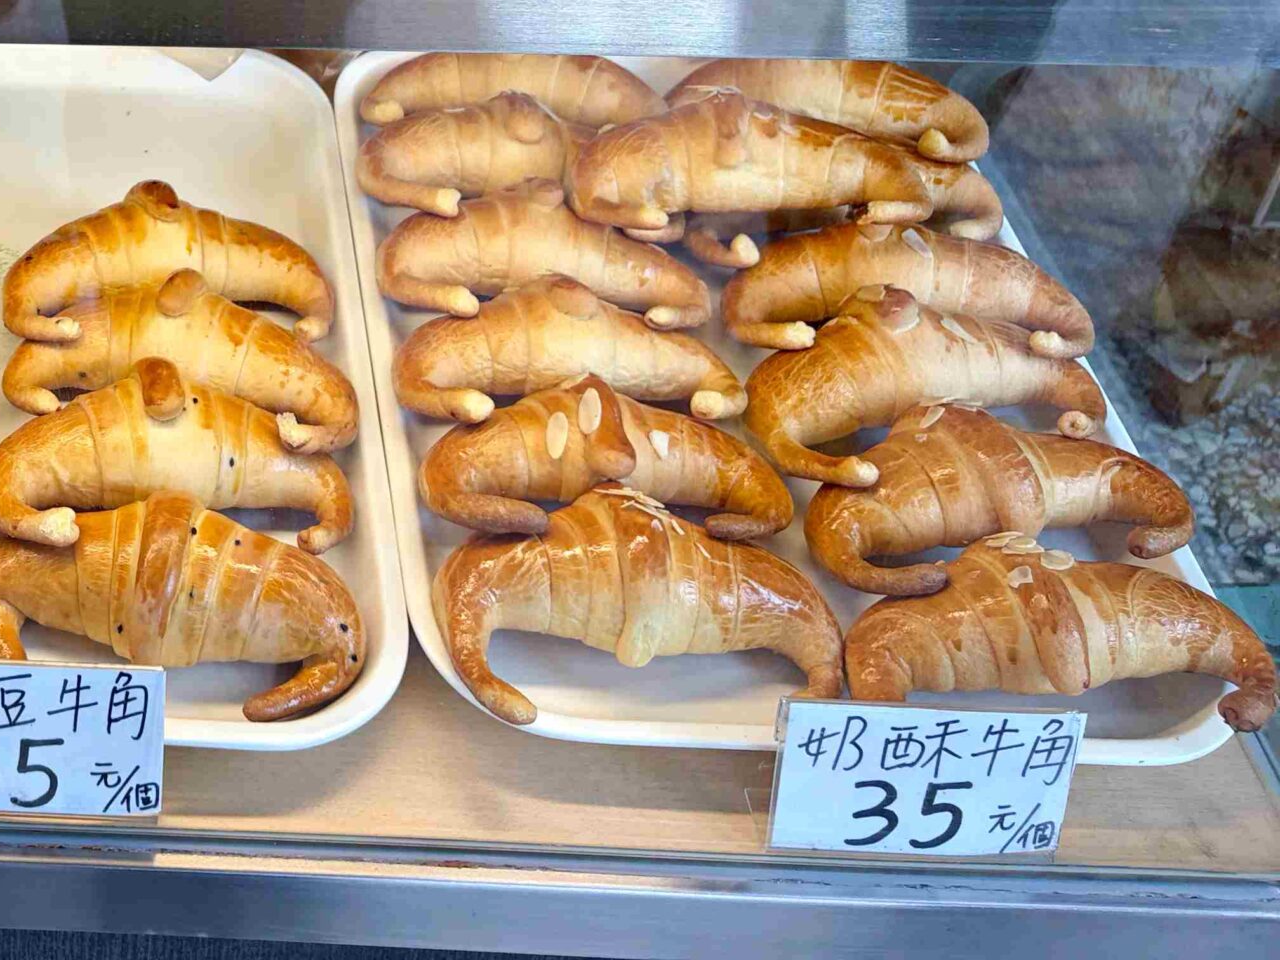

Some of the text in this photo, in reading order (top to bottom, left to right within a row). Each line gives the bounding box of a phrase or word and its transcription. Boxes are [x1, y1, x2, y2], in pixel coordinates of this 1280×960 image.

[90, 762, 161, 814] 元/個
[843, 779, 1057, 854] 35 元/個
